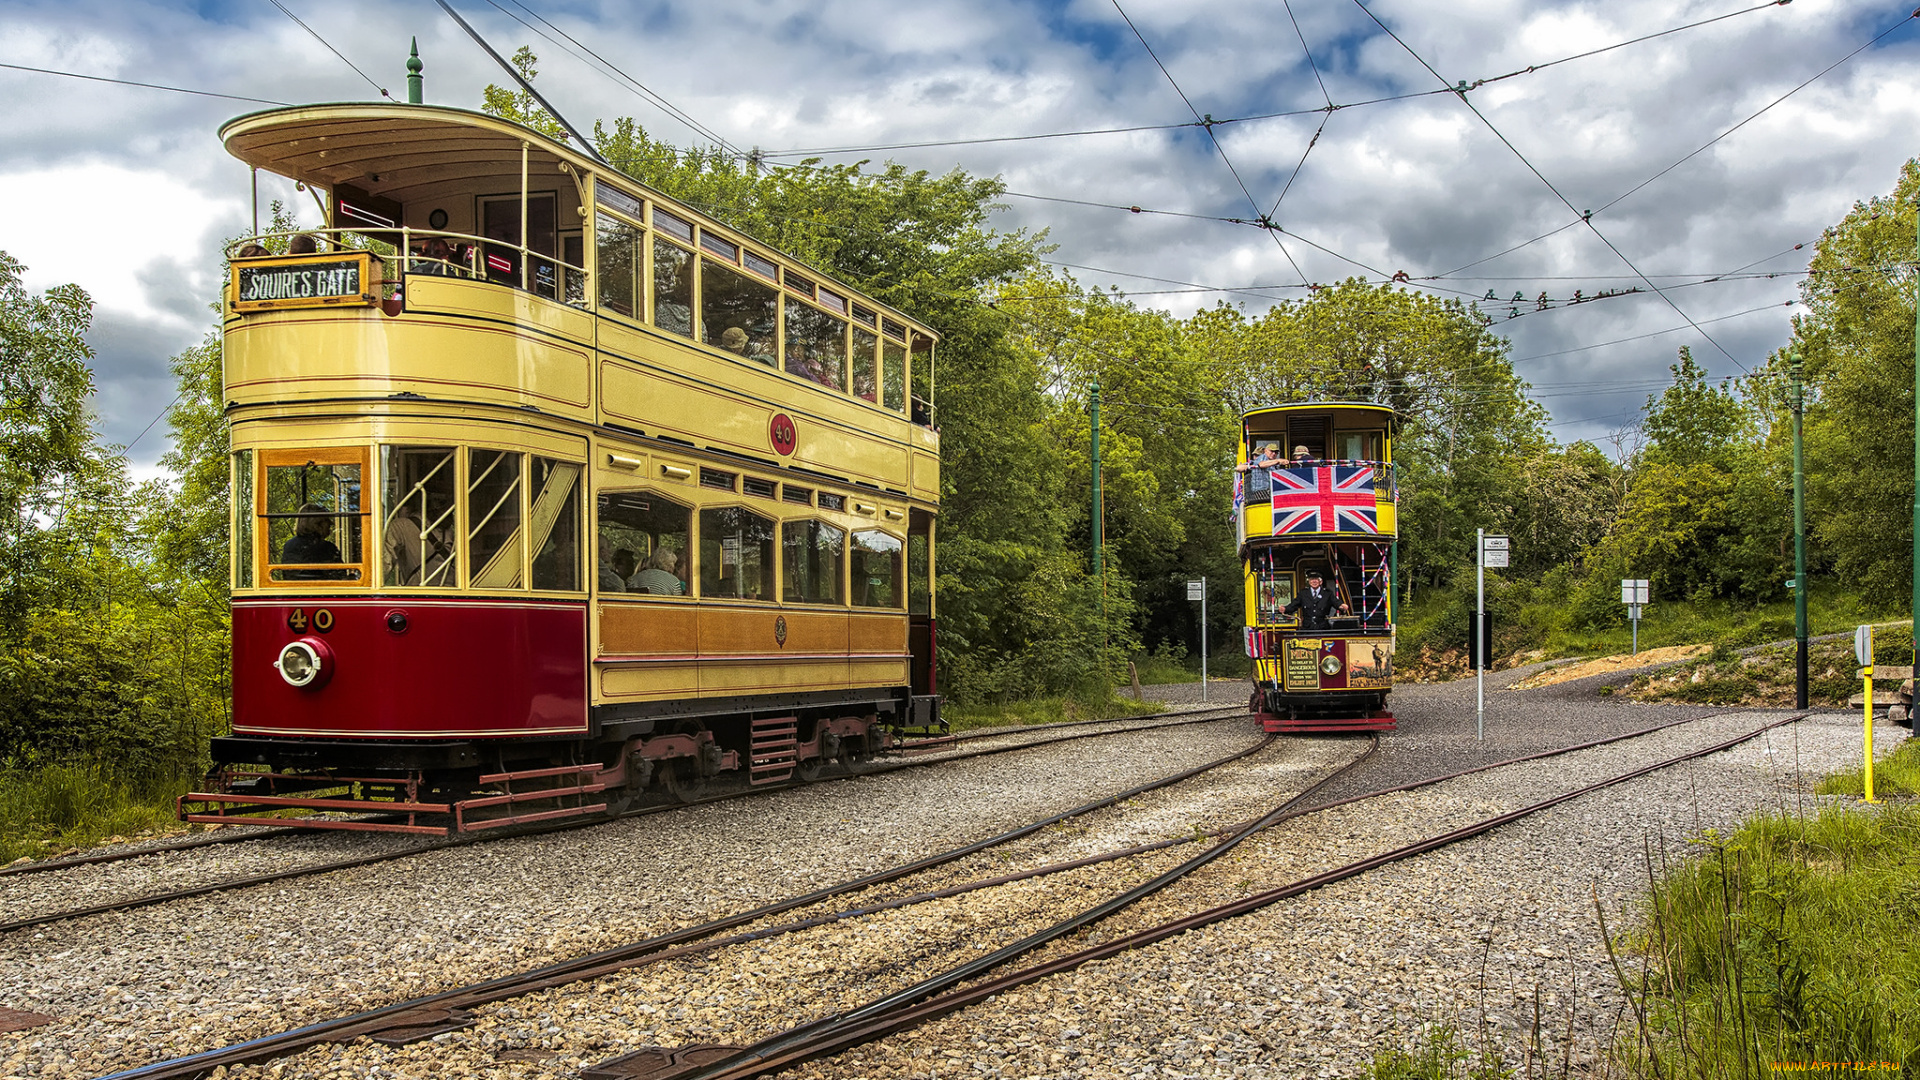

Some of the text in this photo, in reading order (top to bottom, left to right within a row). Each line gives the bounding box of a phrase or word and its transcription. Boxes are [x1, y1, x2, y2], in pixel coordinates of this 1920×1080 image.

[249, 268, 357, 300] SQUIRES GATE
[775, 423, 791, 443] 40
[288, 608, 334, 632] 40
[1290, 649, 1314, 660] MEN
